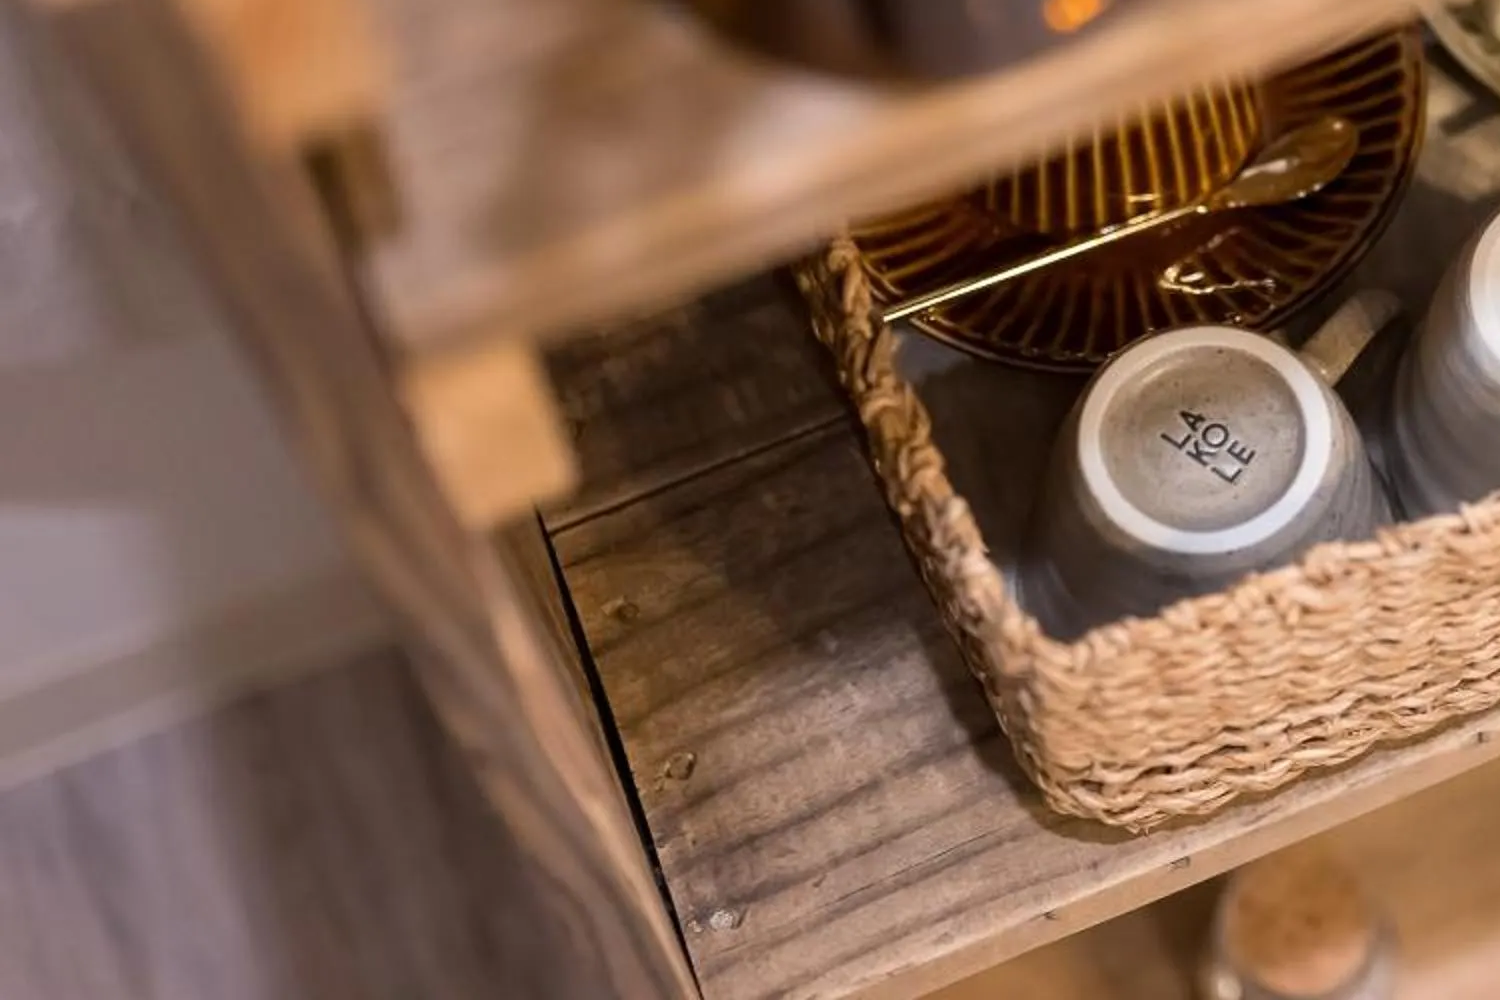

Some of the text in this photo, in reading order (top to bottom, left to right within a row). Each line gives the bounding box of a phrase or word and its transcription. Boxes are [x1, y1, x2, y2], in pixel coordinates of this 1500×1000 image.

[1160, 410, 1206, 450] LA
[1185, 423, 1229, 467] KO
[1210, 440, 1256, 484] LE
